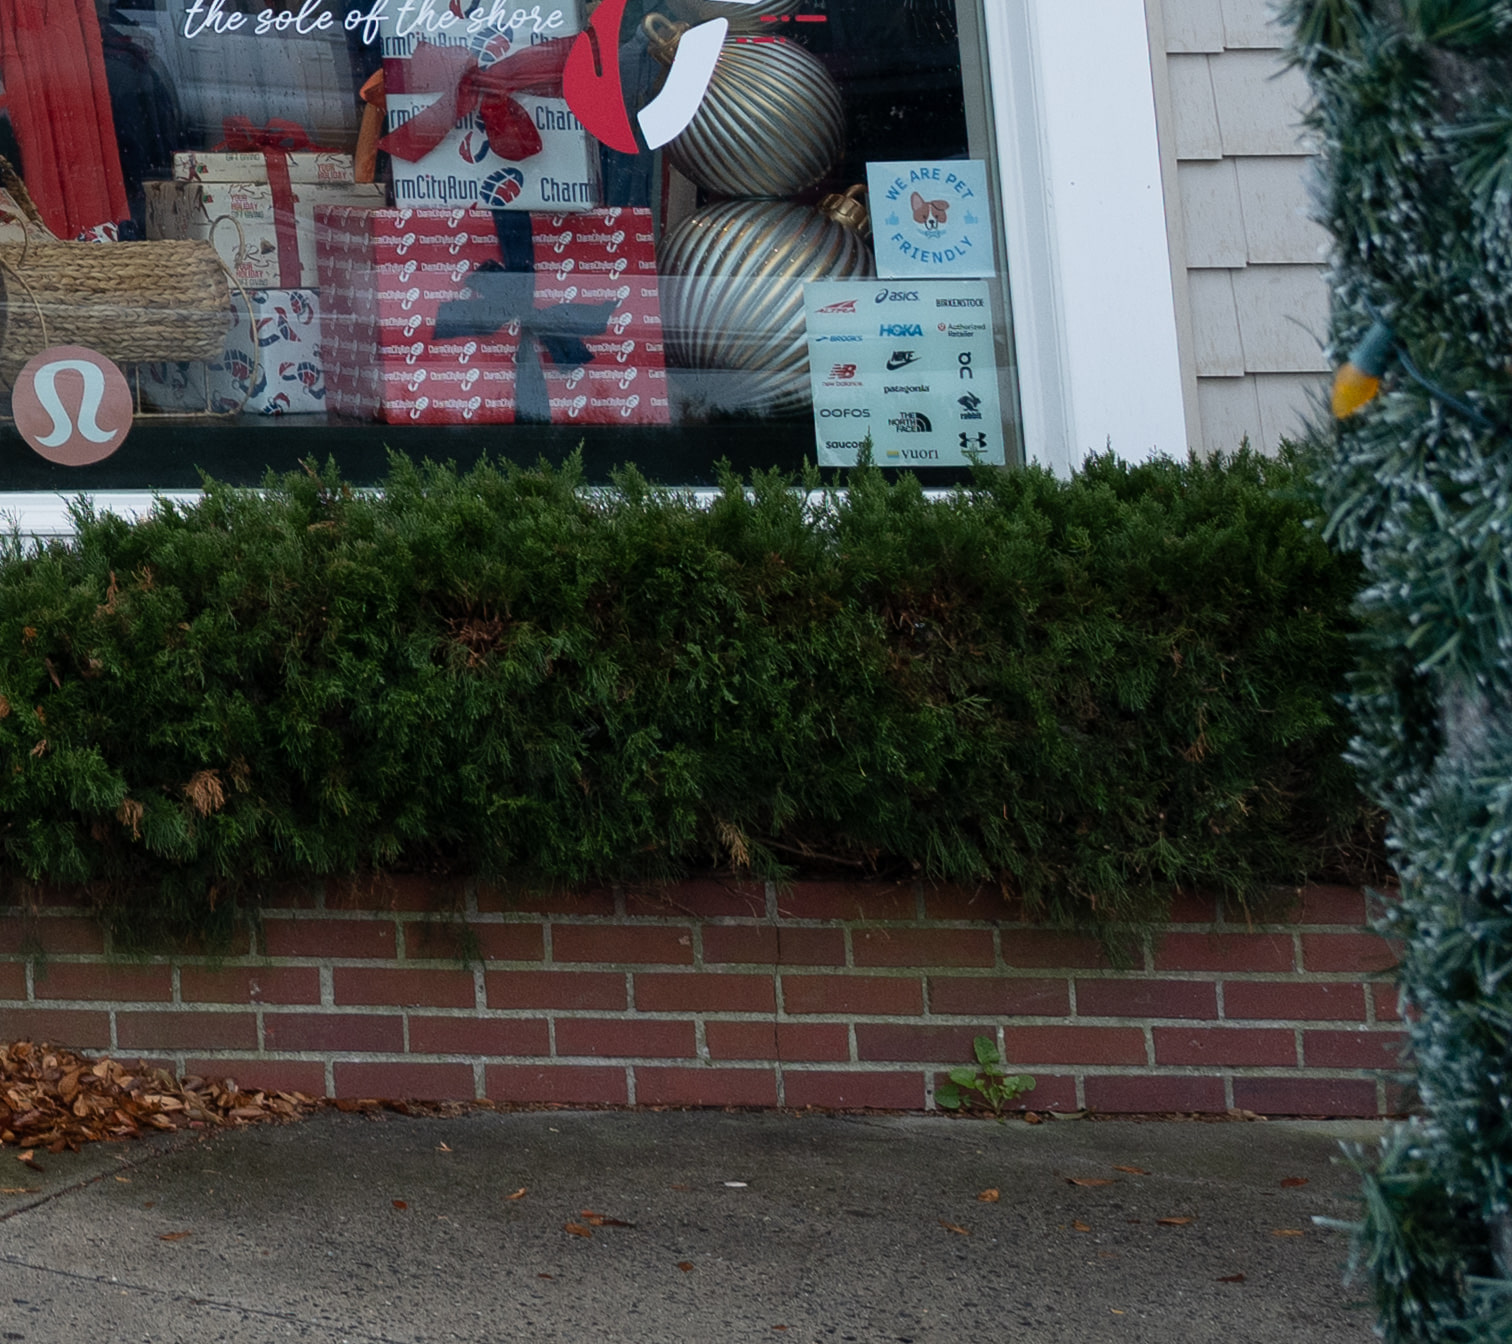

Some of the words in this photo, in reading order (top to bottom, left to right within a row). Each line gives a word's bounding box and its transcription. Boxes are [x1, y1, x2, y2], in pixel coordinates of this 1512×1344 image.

[885, 178, 908, 201] WE
[909, 167, 941, 183] ARE
[945, 173, 974, 199] PET
[891, 233, 973, 264] FRIENDLY
[889, 290, 920, 302] asics
[879, 323, 924, 337] HOKA
[891, 351, 915, 362] NIKE
[884, 385, 930, 394] patagonia
[819, 408, 871, 418] OOFOS
[901, 449, 939, 460] vuori
